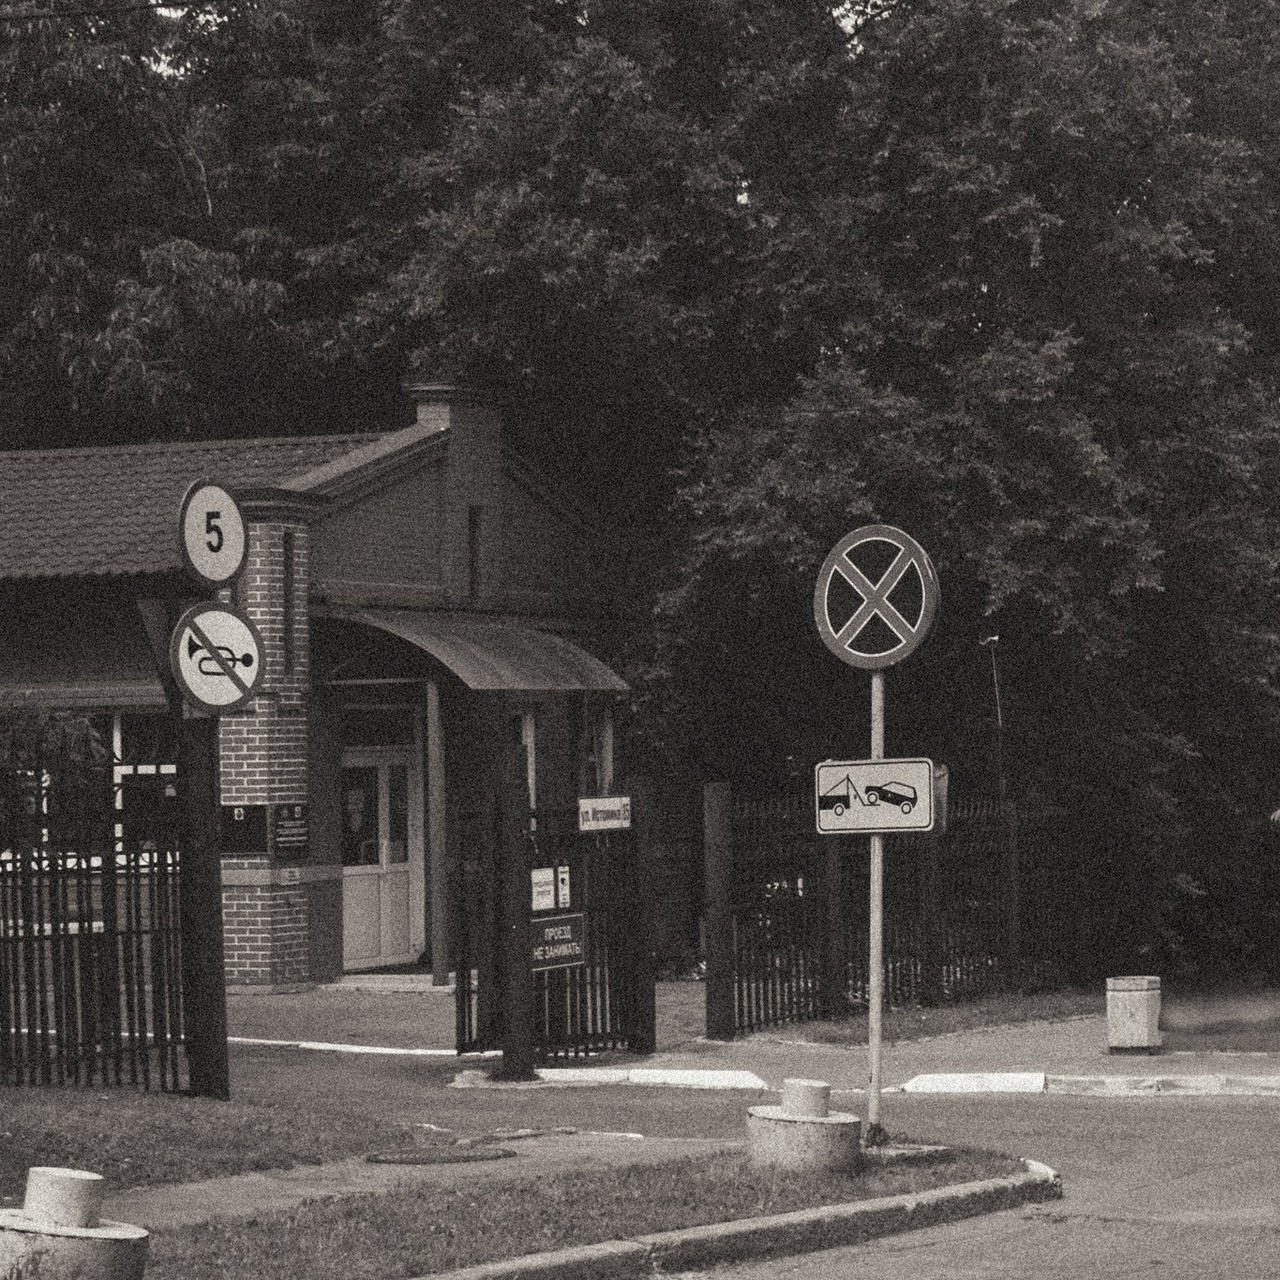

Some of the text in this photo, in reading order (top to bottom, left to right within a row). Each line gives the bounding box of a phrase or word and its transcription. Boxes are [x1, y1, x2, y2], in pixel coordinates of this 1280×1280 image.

[205, 511, 224, 553] 5
[544, 925, 572, 941] ПРОЕЗД
[533, 946, 543, 960] НЕ
